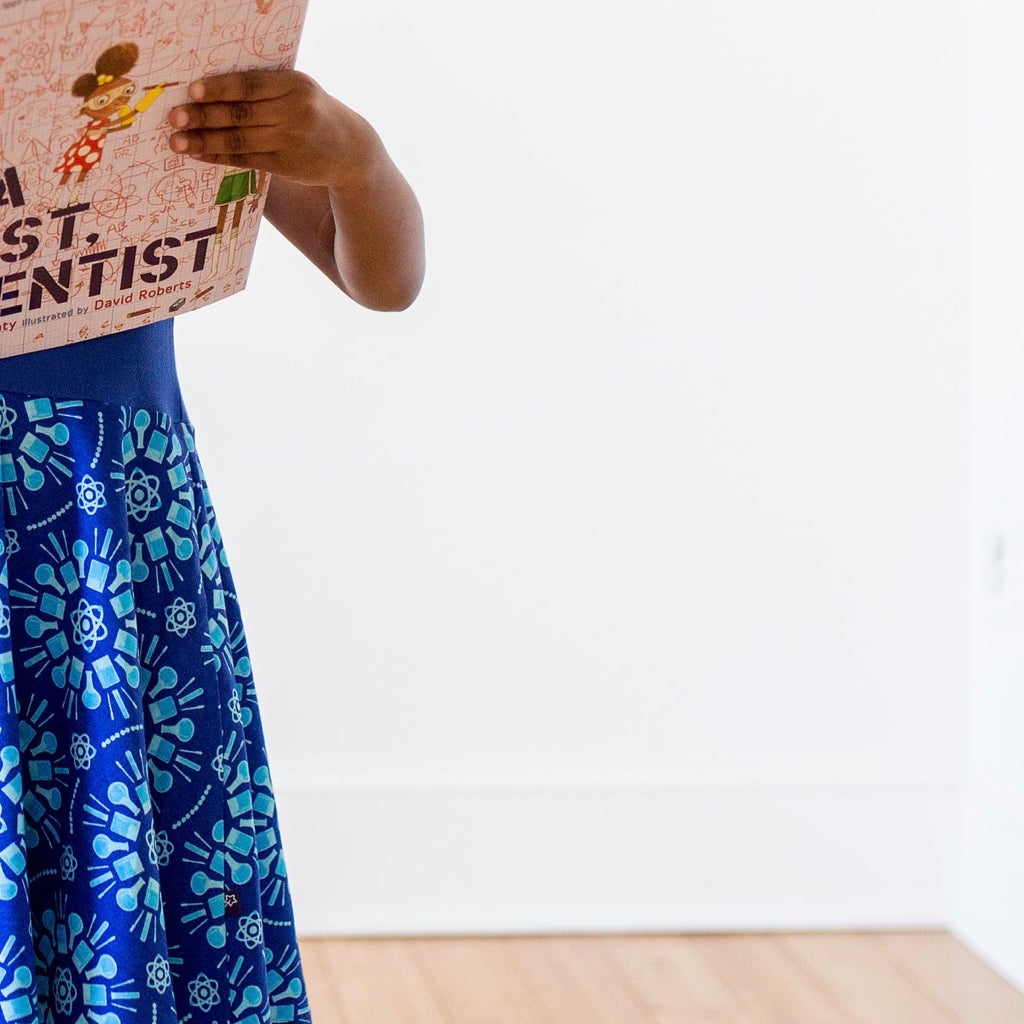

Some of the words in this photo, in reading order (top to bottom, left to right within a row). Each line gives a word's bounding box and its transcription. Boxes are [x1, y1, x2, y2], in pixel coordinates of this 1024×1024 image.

[77, 305, 89, 316] by
[94, 292, 133, 311] David
[138, 278, 192, 300] Roberts
